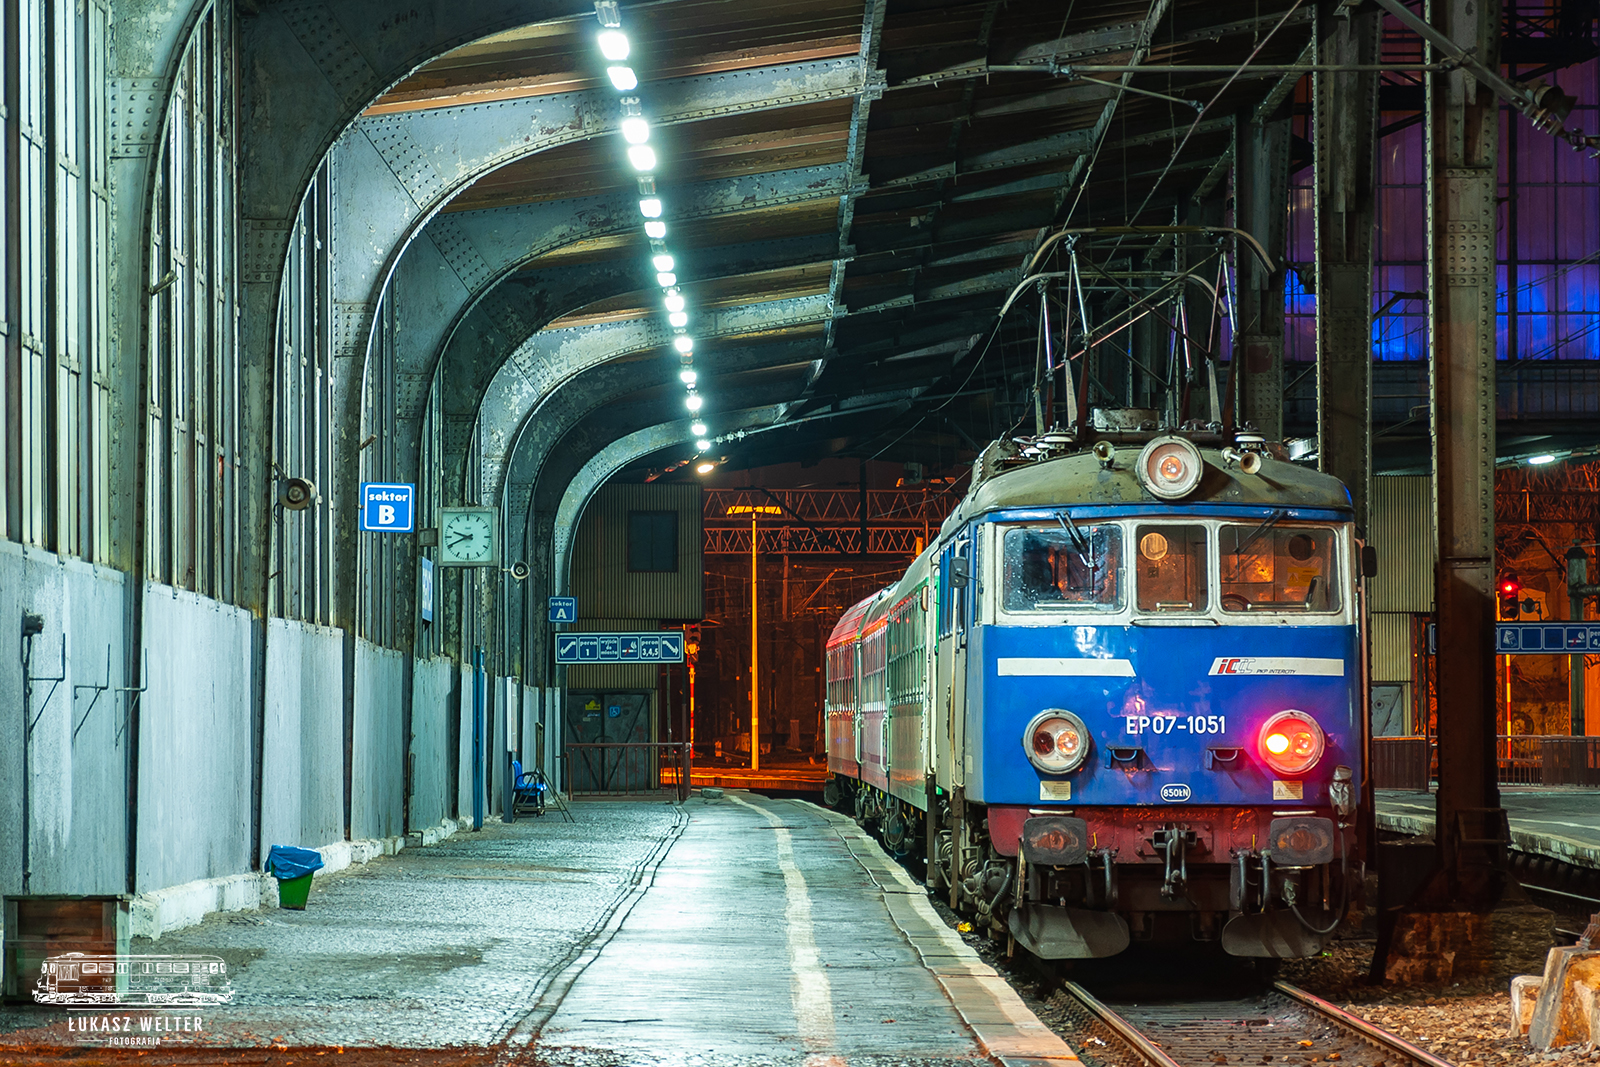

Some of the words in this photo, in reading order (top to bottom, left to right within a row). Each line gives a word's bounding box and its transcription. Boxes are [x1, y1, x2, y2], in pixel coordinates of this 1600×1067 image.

[368, 491, 408, 502] sektor
[378, 505, 395, 525] B
[556, 608, 567, 619] A
[585, 648, 590, 657] 1
[642, 648, 659, 657] 3,4,5
[1126, 715, 1226, 735] EP07-1051
[1163, 788, 1189, 797] 850kN
